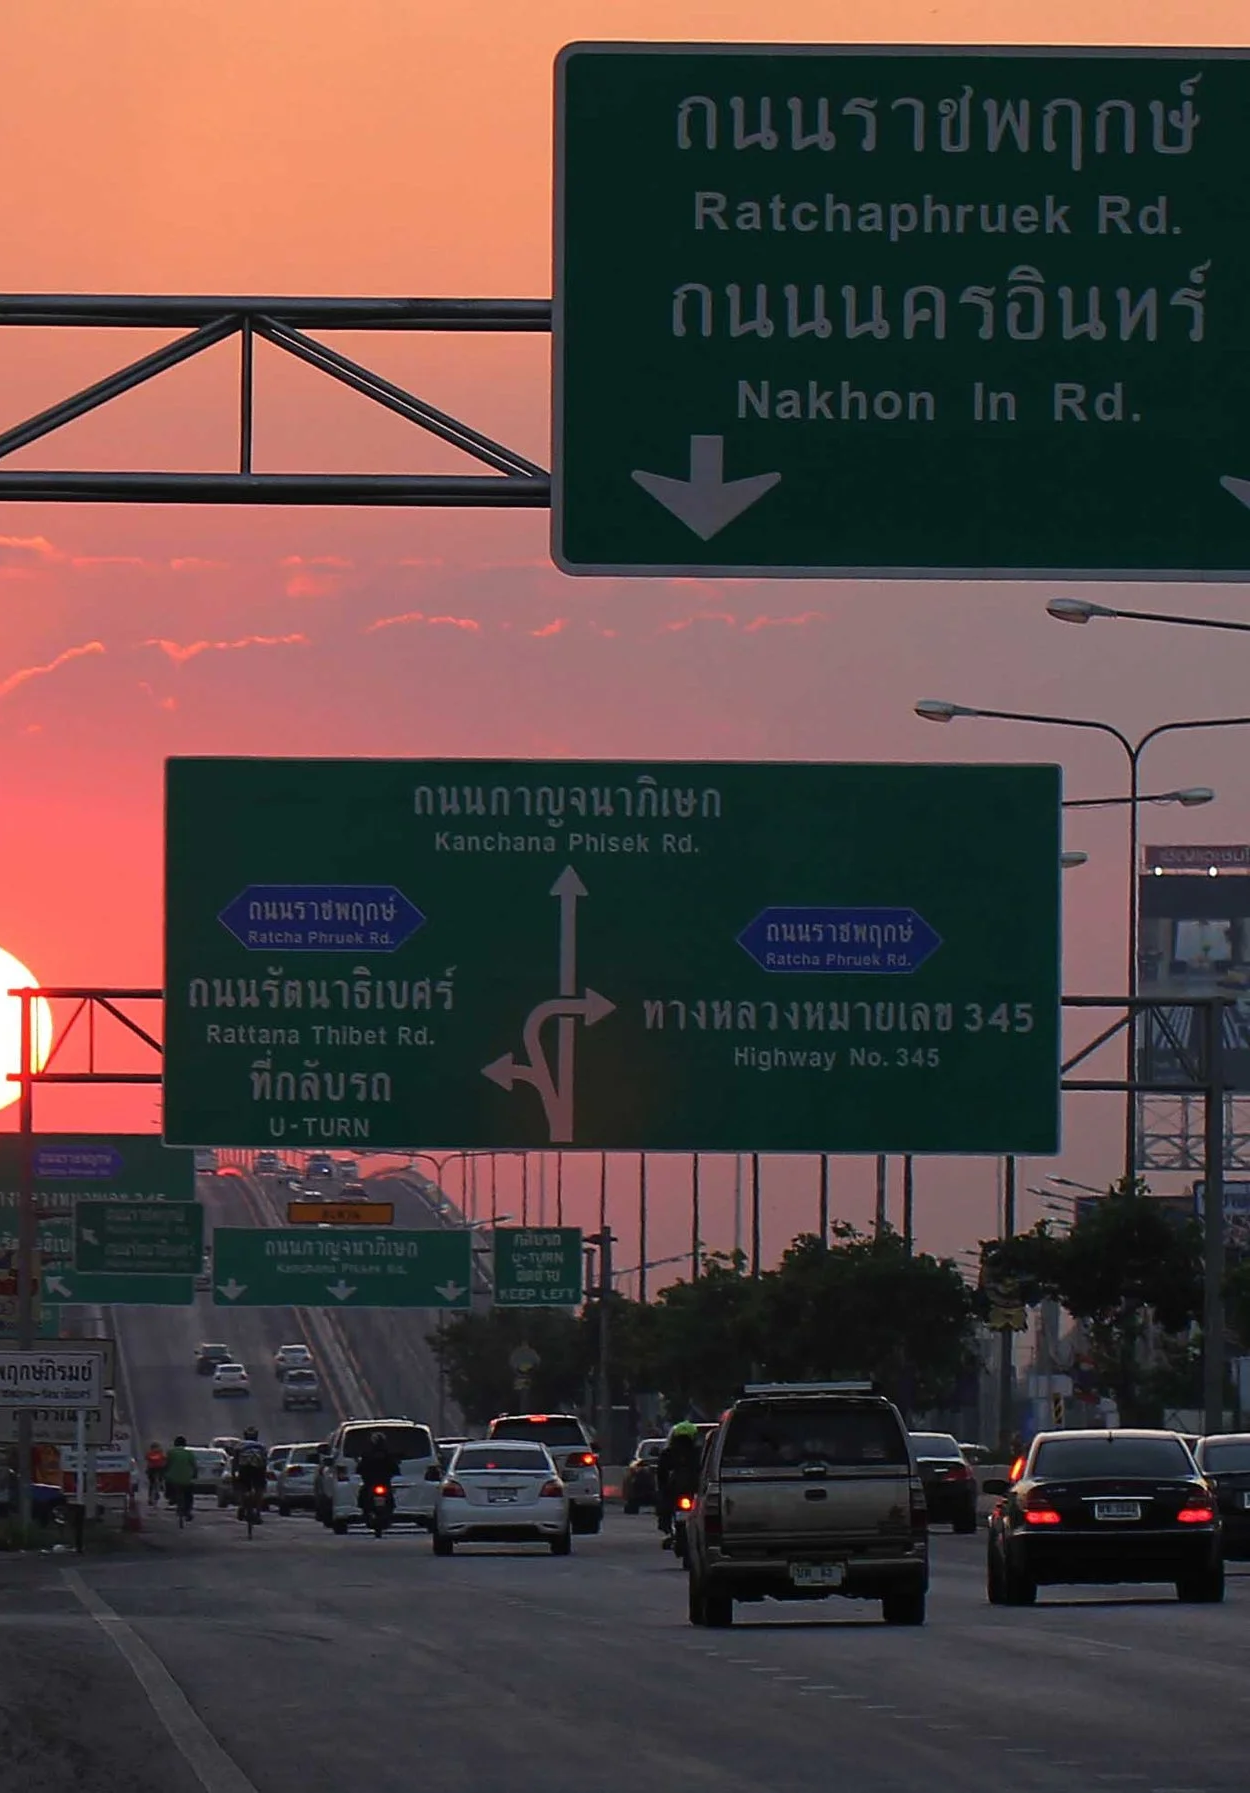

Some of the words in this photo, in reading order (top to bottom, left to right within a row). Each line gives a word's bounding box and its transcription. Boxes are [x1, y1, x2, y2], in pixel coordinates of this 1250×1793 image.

[676, 72, 1203, 172] ถนนราชพฤกษ์
[694, 191, 1072, 242] Ratchaphruek
[1097, 195, 1182, 235] Rd.
[671, 259, 1212, 342] ถนนนครอินทร์
[737, 379, 935, 421] Nakhon
[973, 382, 1016, 421] In
[1053, 382, 1142, 422] Rd.
[414, 774, 721, 829] ถนนกาญจนาภิเษก
[435, 831, 558, 853] Kanchana
[569, 832, 649, 853] Phisek
[662, 833, 700, 854] Rd.
[248, 895, 398, 926] ถนนราชพฤกษ์
[249, 930, 302, 945] Ratcha
[308, 931, 364, 946] Phruek
[369, 931, 395, 945] Rd.
[766, 917, 914, 948] ถนนราชพฤกษ์
[767, 952, 820, 967] Ratcha
[825, 953, 881, 967] Phruek
[886, 953, 912, 967] Rd.
[188, 965, 457, 1010] ถนนรัตนาธิเบศร์
[642, 999, 953, 1032] ทางหลวงหมายเลข
[964, 1003, 1034, 1033] 345
[206, 1024, 300, 1046] Rattana
[311, 1025, 387, 1046] Thibet
[398, 1025, 436, 1046] Rd.
[734, 1046, 837, 1073] Highway
[849, 1047, 889, 1068] No.
[896, 1047, 941, 1068] 345
[249, 1050, 391, 1102] ที่กลับรถ
[269, 1117, 370, 1139] U-TURN
[499, 1287, 536, 1300] KEEP
[539, 1287, 576, 1300] LEFT
